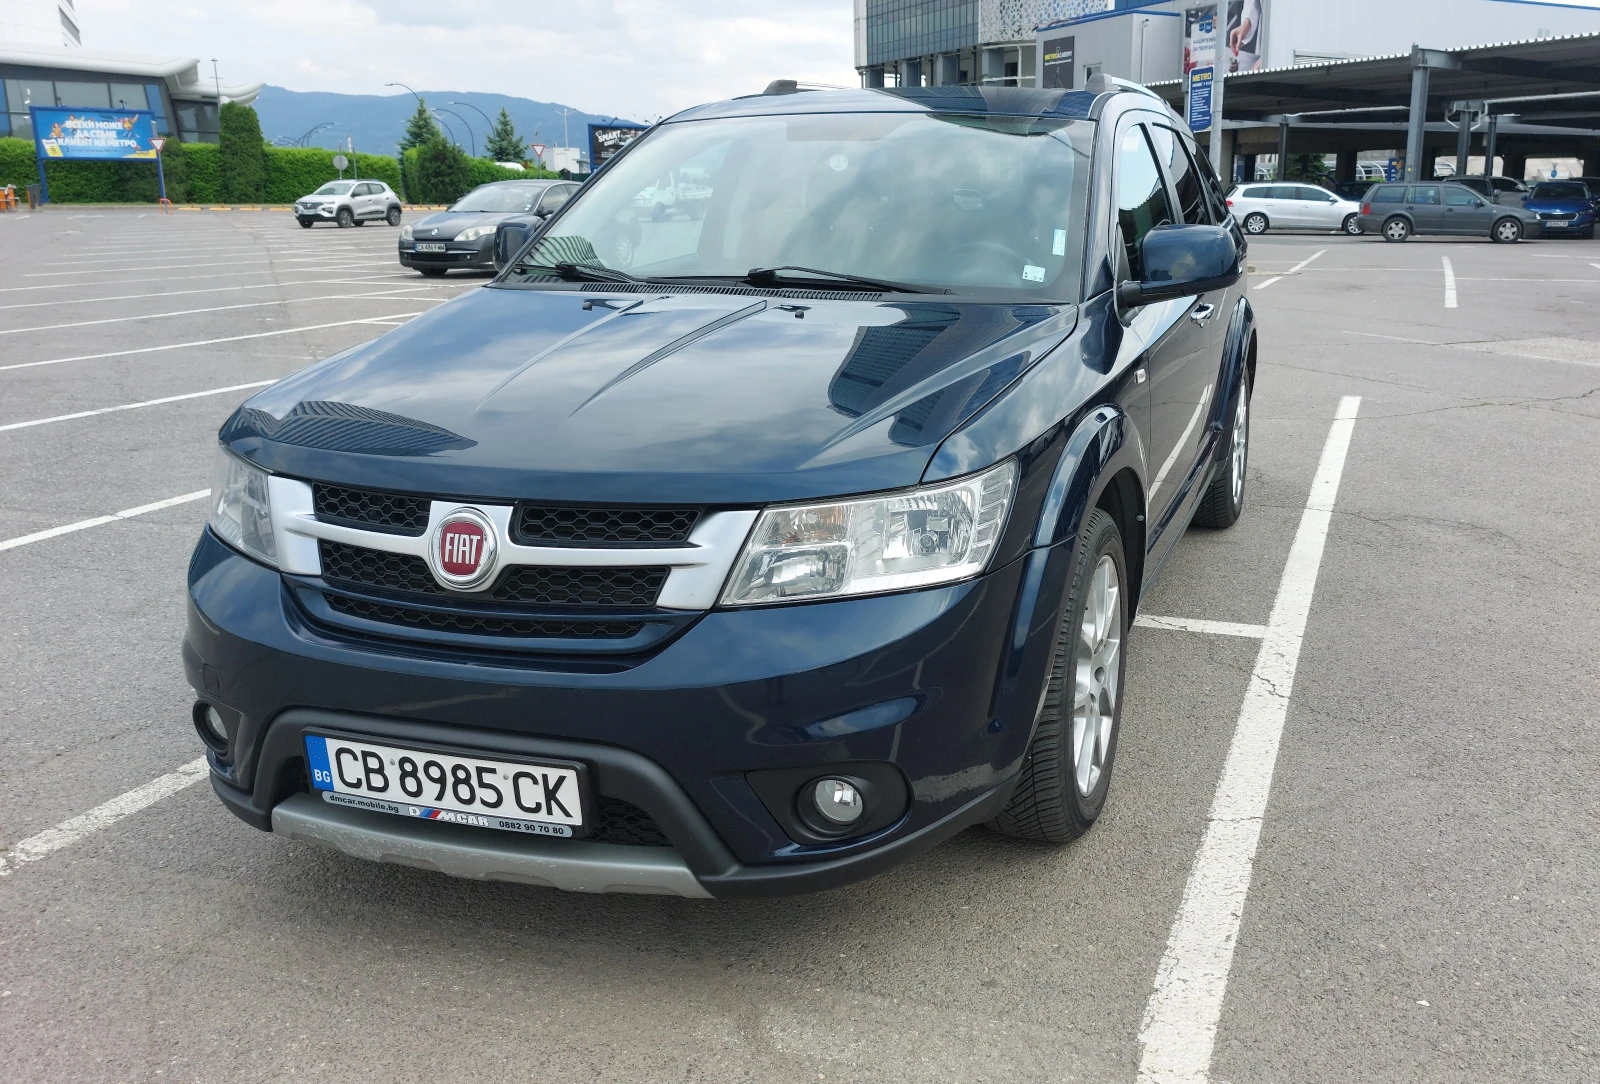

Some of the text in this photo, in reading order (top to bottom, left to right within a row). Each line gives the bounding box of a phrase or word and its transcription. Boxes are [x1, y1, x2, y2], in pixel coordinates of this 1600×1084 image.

[1192, 72, 1212, 82] METRO
[65, 120, 124, 130] ВСЕКИ МОЖЕ
[75, 130, 118, 139] ДА СТАНЕ
[598, 130, 620, 142] SMART
[57, 138, 93, 146] КЛИЕНТ
[94, 139, 106, 147] НА
[106, 139, 137, 148] МЕТРО
[444, 532, 481, 565] FIAT
[314, 768, 331, 783] BG
[335, 747, 574, 818] CB 8985 CK
[329, 794, 399, 813] dmcar.mobile.bg
[499, 820, 522, 829] 0882
[524, 823, 536, 831] 90
[538, 825, 549, 833] 70
[552, 827, 564, 835] 80
